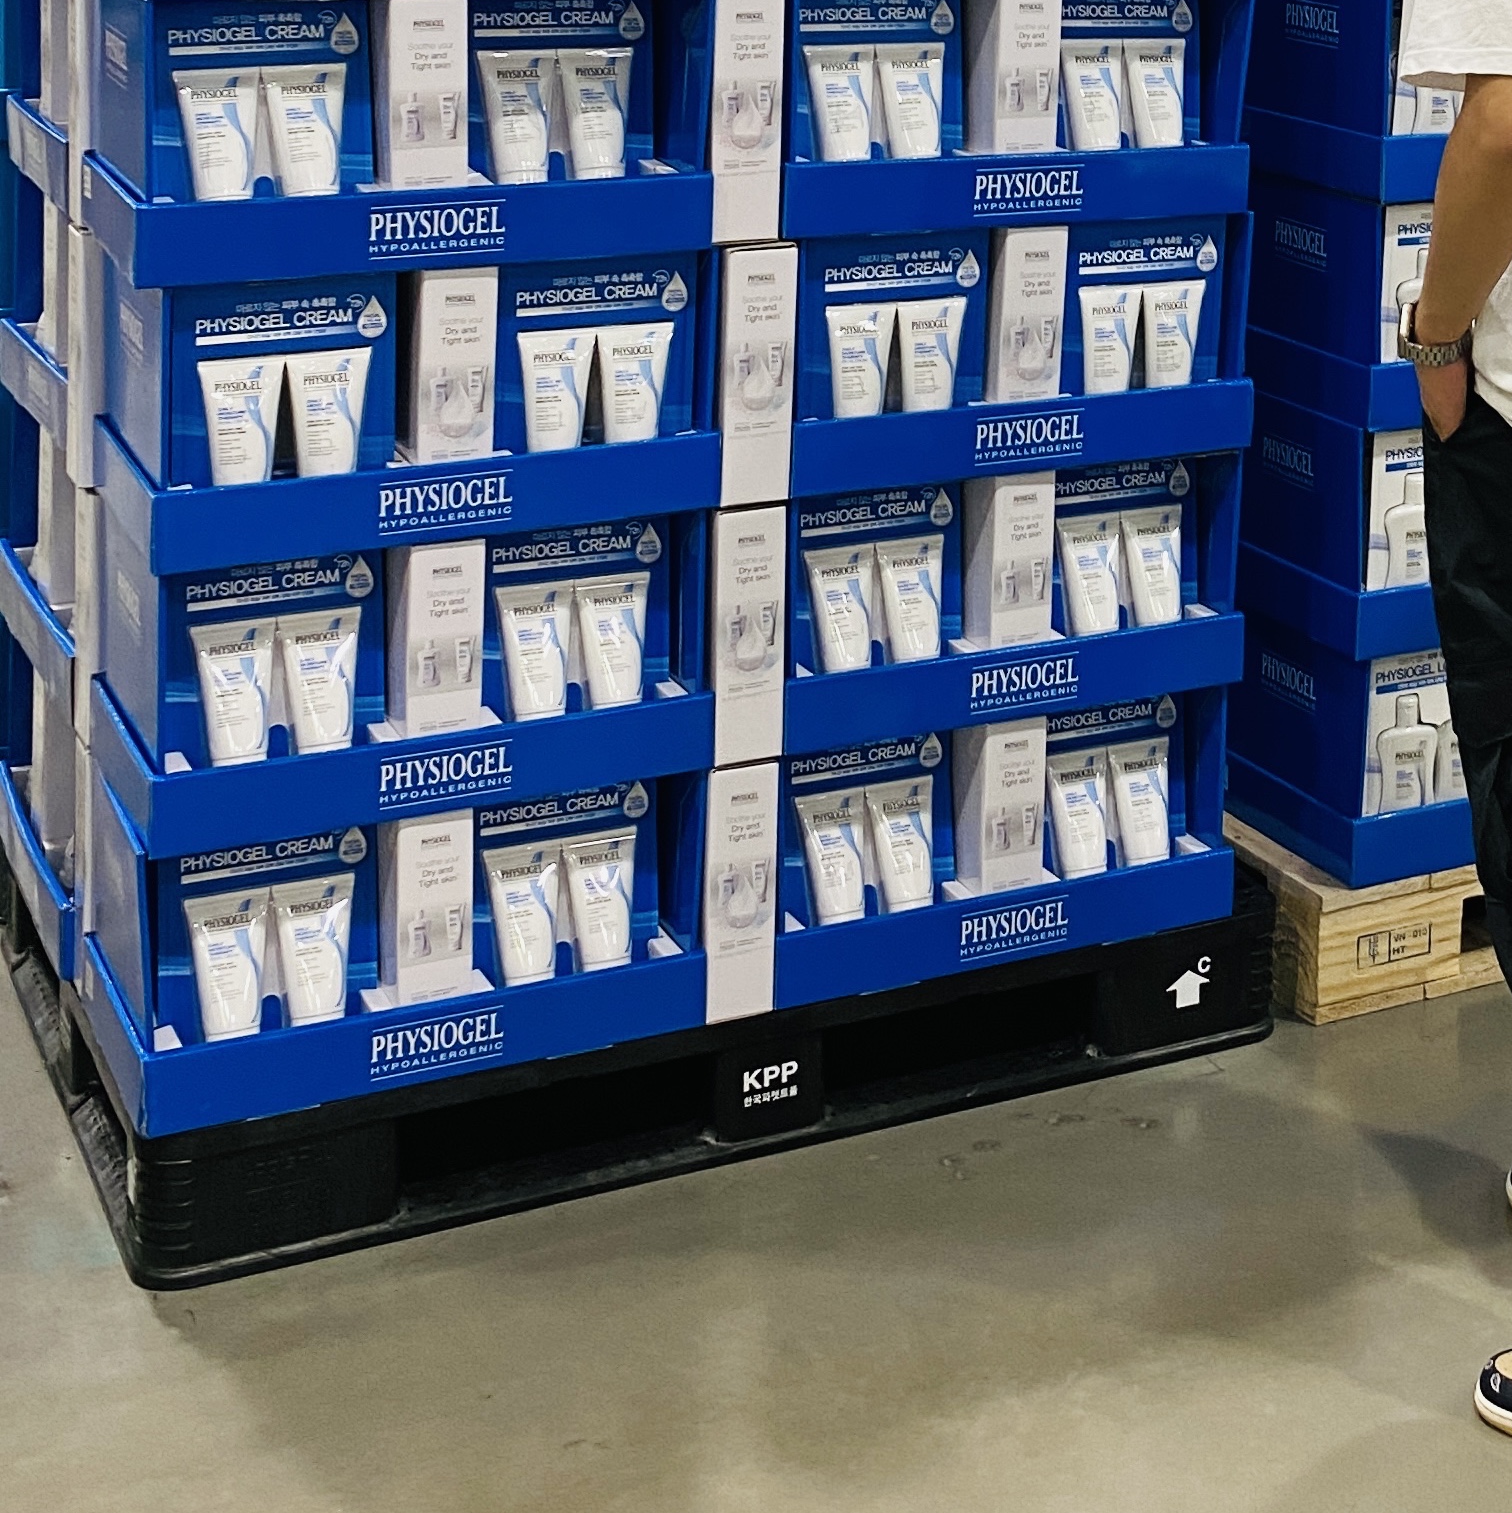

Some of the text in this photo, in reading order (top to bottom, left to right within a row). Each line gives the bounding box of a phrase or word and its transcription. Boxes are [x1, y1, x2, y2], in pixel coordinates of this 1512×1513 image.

[168, 25, 325, 44] PHYSIOGEL CREAM
[1285, 2, 1340, 35] PHYSIOGEL
[974, 170, 1084, 200] PHYSIOGEL
[973, 198, 1083, 211] HYPOALLERGENIC
[369, 206, 506, 242] PHYSIOGEL
[1275, 220, 1327, 258] PHYSIOGEL
[368, 236, 506, 254] HYPOALLERGENIC
[825, 260, 953, 282] PHYSIOGEL CREAM
[195, 309, 353, 335] PHYSIOGEL CREAM
[975, 414, 1084, 451] PHYSIOGEL
[974, 443, 1083, 460] HYPOALLERGENIC
[1262, 435, 1315, 478] PHYSIOGEL
[378, 476, 512, 518] PHYSIOGEL
[378, 506, 512, 530] HYPOALLERGENIC
[186, 567, 341, 601] PHYSIOGEL CREAM
[970, 657, 1079, 698] PHYSIOGEL
[1261, 653, 1317, 703] PHYSIOGEL
[1375, 662, 1435, 686] PHYSIOGEL
[970, 684, 1078, 709] HYPOALLERGENIC
[379, 747, 512, 791] PHYSIOGEL
[791, 744, 916, 776] PHYSIOGEL CREAM
[379, 775, 512, 803] HYPOALLERGENIC
[480, 794, 618, 827] PHYSIOGEL CREAM
[960, 901, 1069, 945] PHYSIOGEL
[959, 927, 1068, 956] HYPOALLERGENIC
[1197, 955, 1211, 974] C
[370, 1013, 504, 1064] PHYSIOGEL
[370, 1041, 504, 1075] HYPOALLERGENIC
[743, 1060, 799, 1093] KPP
